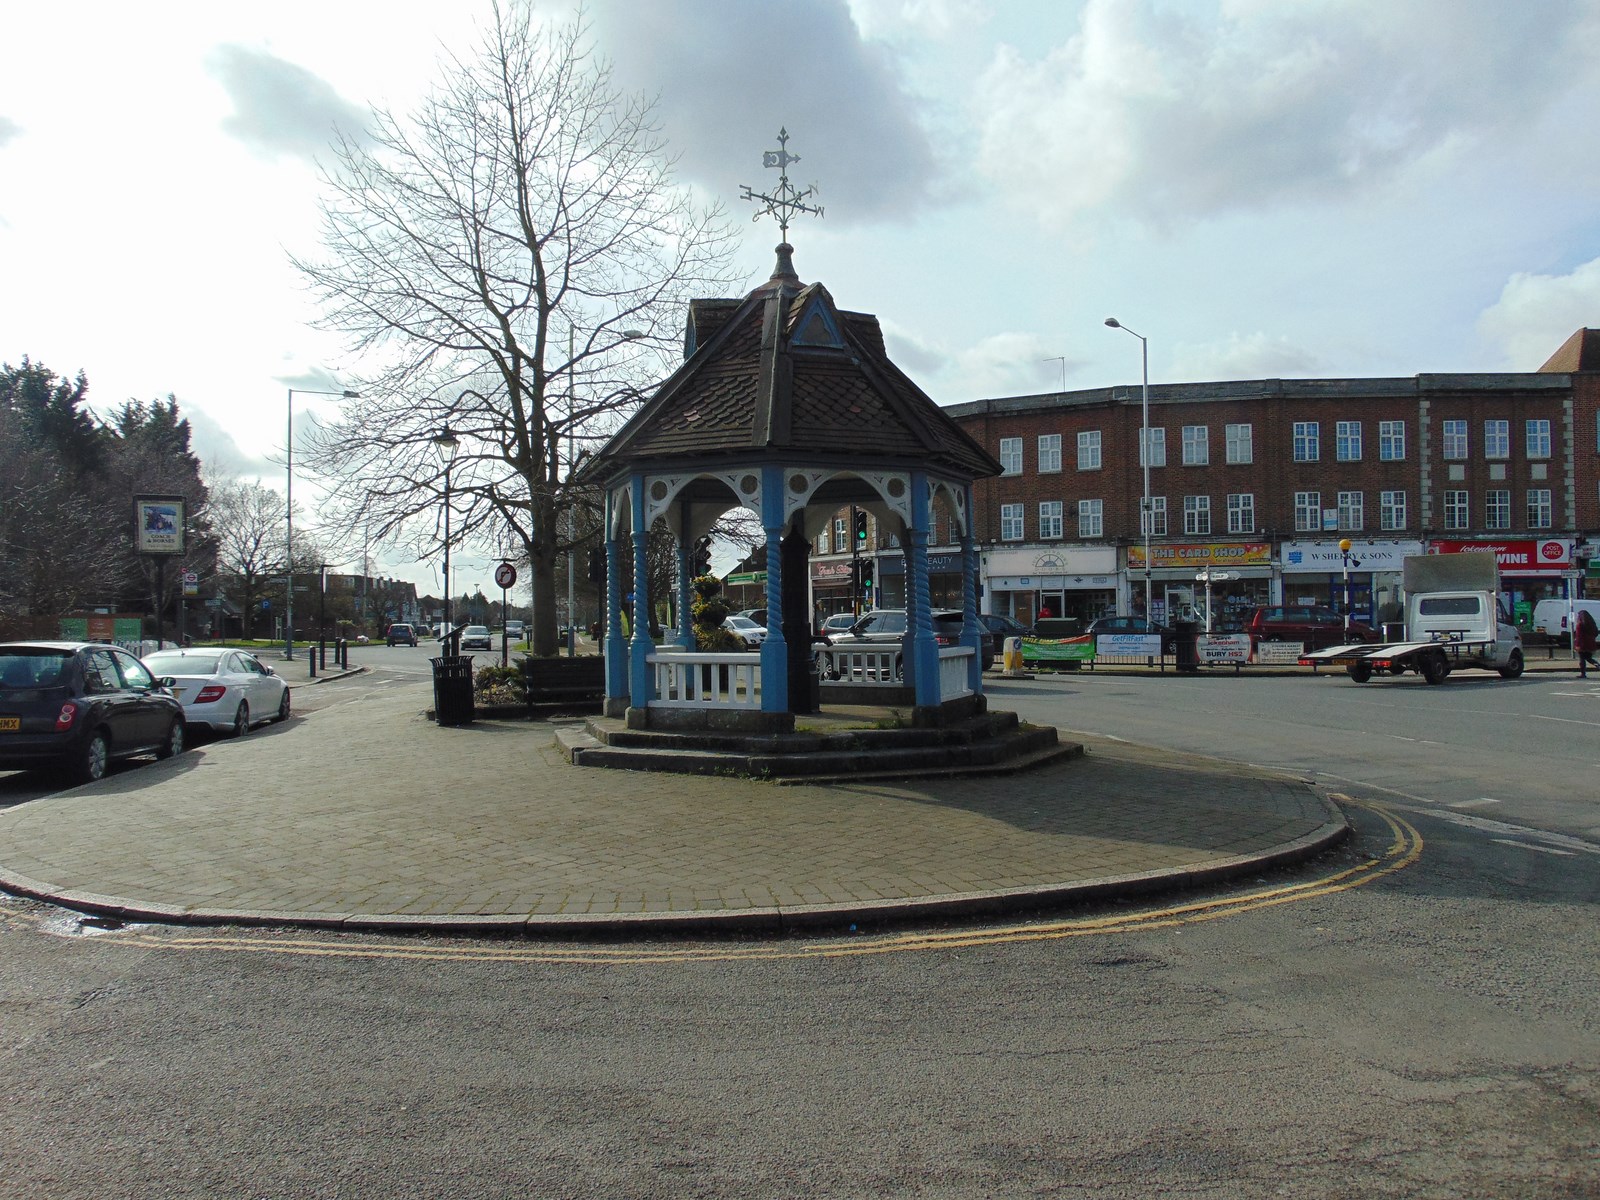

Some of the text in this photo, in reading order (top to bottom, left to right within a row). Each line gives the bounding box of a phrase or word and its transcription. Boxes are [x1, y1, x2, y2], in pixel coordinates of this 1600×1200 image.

[1152, 547, 1245, 558] THE CARD SHOP
[928, 557, 953, 565] EAUTY
